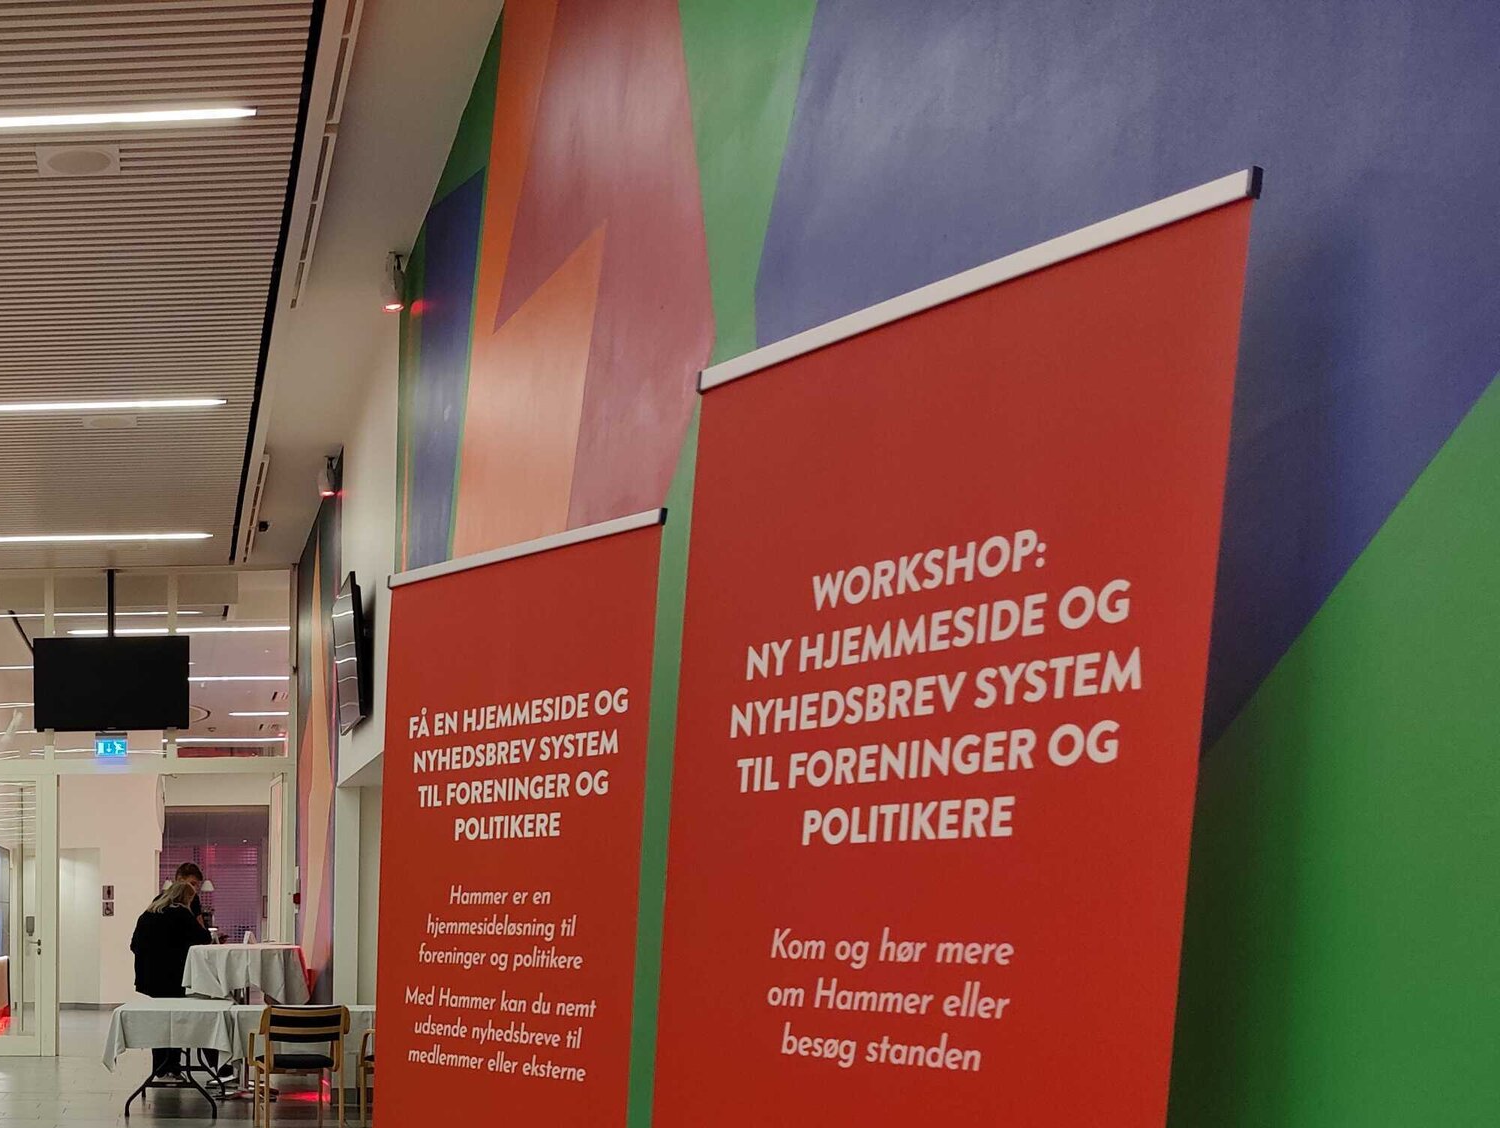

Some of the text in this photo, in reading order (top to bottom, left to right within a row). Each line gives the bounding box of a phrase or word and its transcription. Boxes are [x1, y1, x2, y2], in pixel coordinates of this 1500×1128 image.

[812, 528, 1047, 612] WORKSHOP:
[746, 578, 1132, 681] NY HJEMMESIDE OG
[408, 687, 629, 739] FÅ EN HJEMMESIDE OG
[729, 646, 1143, 739] NYHEDSBREV SYSTEM
[413, 728, 619, 773] NYHEDSBREV SYSTEM
[736, 719, 1120, 794] TIL FORENINGER OG
[418, 769, 609, 808] TIL FORENINGER OG
[454, 811, 561, 841] POLITIKERE
[801, 795, 1016, 846] POLITIKERE
[449, 884, 551, 905] Hammer er en
[426, 913, 577, 941] hjemmesideløsning til
[770, 926, 1015, 970] Kom og hør mere
[418, 942, 583, 971] foreninger og politikere
[405, 985, 597, 1018] Med Hammer kan du nemt
[767, 977, 1011, 1020] om Hammer eller
[414, 1015, 583, 1049] udsende nyhedsbreve til
[781, 1021, 982, 1073] besøg standen
[407, 1045, 586, 1082] medlemmer eller eksterne
